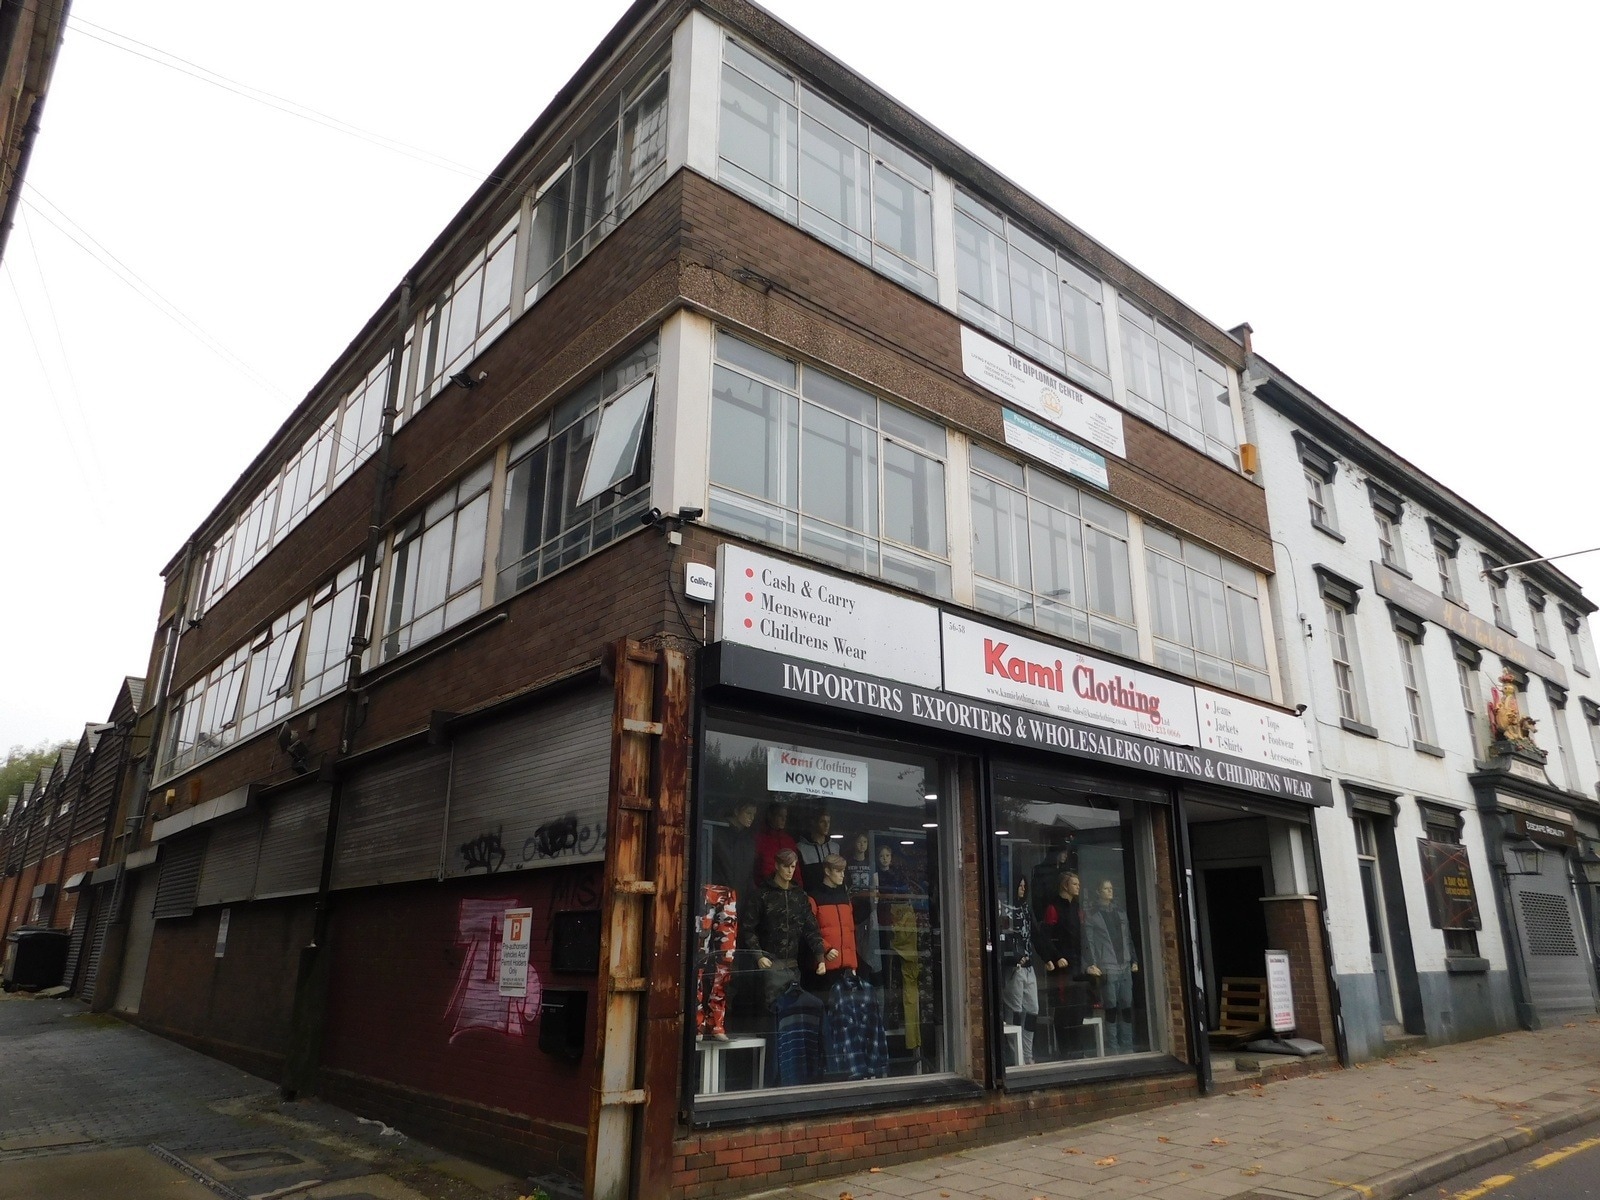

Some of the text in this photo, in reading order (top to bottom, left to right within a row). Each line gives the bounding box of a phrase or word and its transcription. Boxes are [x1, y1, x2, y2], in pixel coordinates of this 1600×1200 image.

[1008, 355, 1022, 371] THE
[1023, 363, 1057, 390] DIPLOMAT
[1059, 383, 1084, 405] CENTRE
[761, 568, 856, 614] Cash & Carry
[760, 593, 832, 627] Menswear
[949, 622, 966, 634] 56-58
[760, 618, 867, 660] Childrens Wear
[983, 638, 1064, 693] Kami
[1072, 664, 1162, 725] Clothing
[986, 687, 1050, 708] www.kamiclothing.co.uk
[1213, 701, 1231, 716] Jeans
[782, 663, 1313, 799] IMPORTERS EXPORTERS & WHOLESALERS OF MENS & CHILDRENS WEAR
[1215, 718, 1239, 735] Jackets
[1265, 716, 1280, 732] Tops
[1216, 735, 1243, 753] T-Shirts
[1267, 732, 1294, 750] Footwear
[781, 752, 857, 778] Kami Clothing
[1270, 750, 1303, 767] Accessories
[785, 771, 852, 791] NOW OPEN
[512, 922, 520, 939] P
[509, 967, 517, 976] Only
